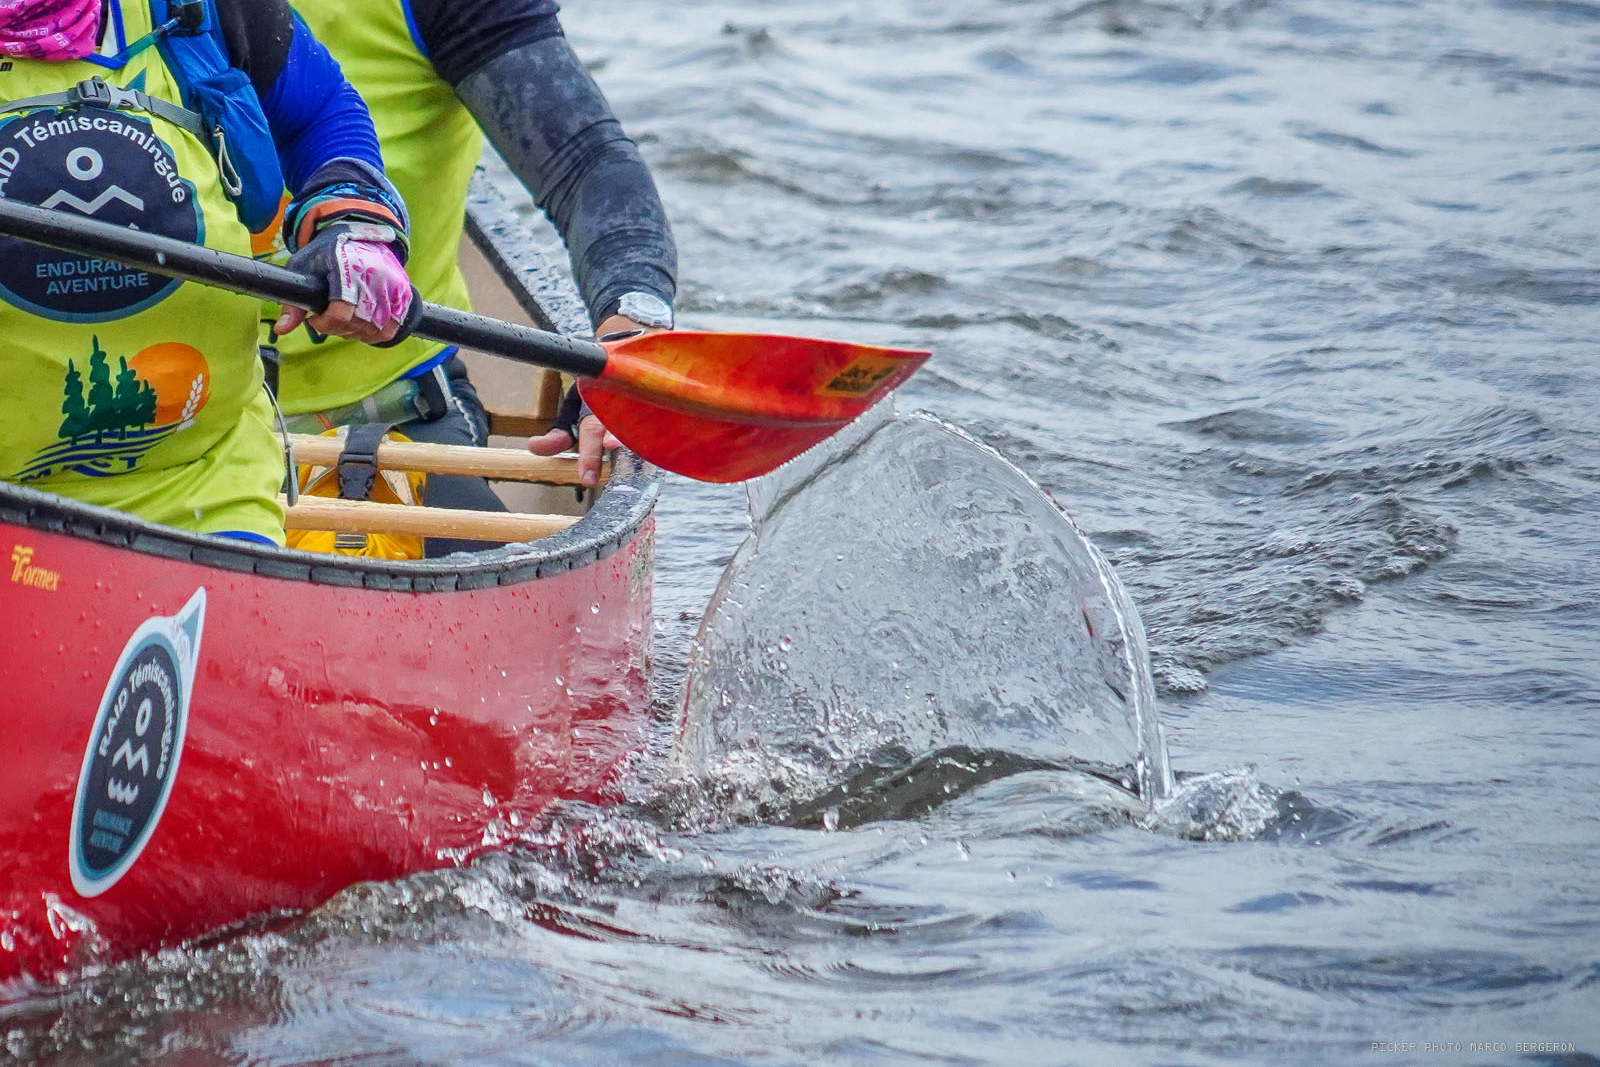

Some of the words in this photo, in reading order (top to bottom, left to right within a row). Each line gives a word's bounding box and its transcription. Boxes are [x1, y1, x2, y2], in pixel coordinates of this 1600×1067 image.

[13, 115, 186, 204] Témiscamingue
[46, 272, 149, 295] AVENTURE
[99, 687, 128, 758] RAID
